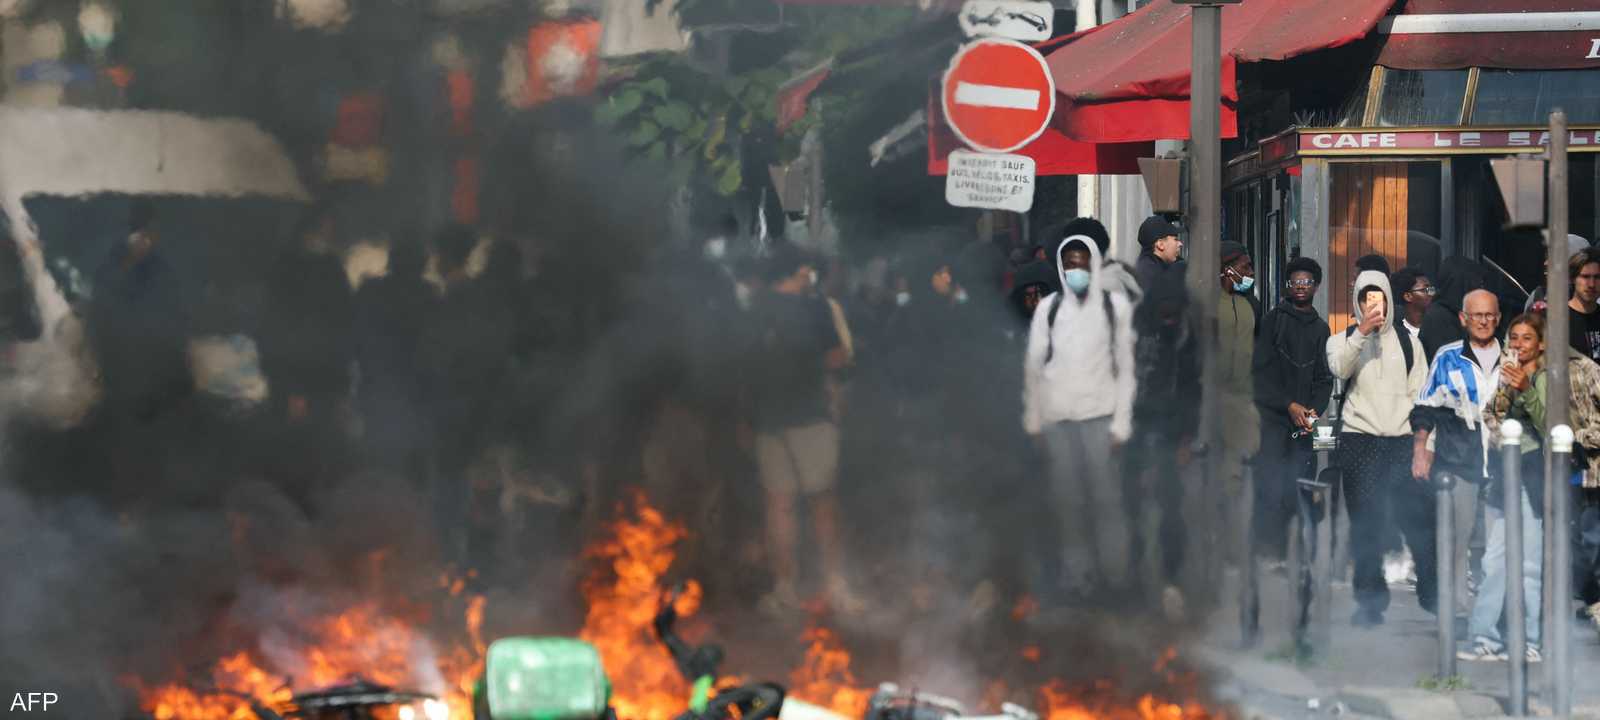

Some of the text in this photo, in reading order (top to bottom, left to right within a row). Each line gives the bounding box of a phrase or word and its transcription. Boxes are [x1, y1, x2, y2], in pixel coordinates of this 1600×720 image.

[1312, 130, 1600, 148] CAFE LE SAL
[1002, 160, 1025, 170] SAUF
